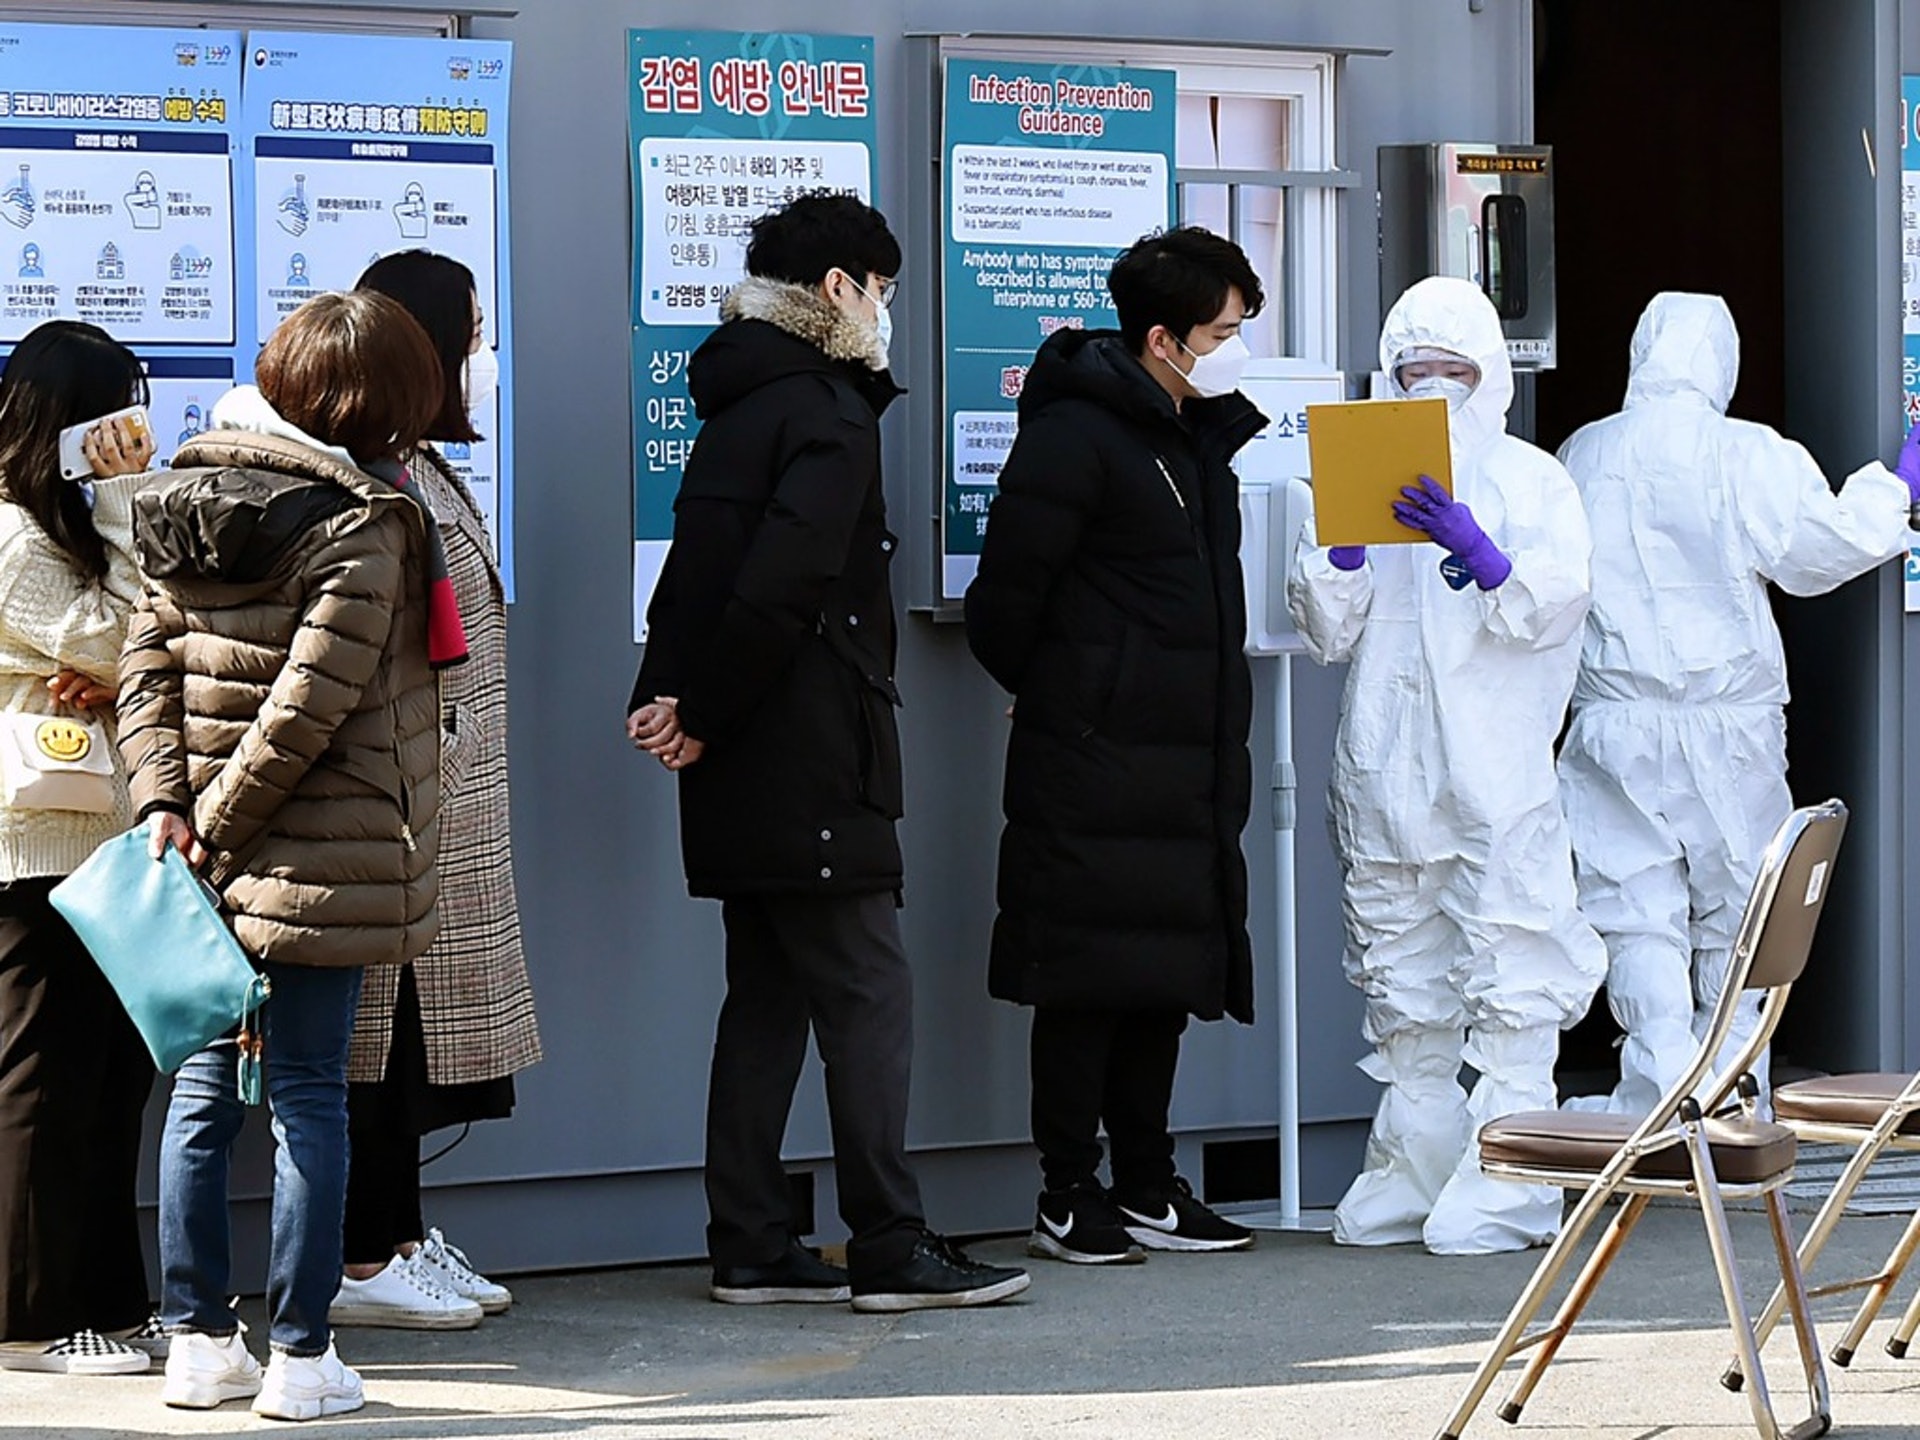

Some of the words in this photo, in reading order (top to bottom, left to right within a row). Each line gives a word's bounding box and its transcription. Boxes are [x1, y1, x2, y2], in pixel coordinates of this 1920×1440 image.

[640, 57, 702, 112] 감염
[712, 58, 773, 116] 예방
[778, 60, 870, 117] 안내문
[970, 75, 1051, 105] Infection
[1057, 80, 1152, 111] Prevention
[13, 93, 161, 120] 코로나바이러스감염증
[163, 97, 193, 121] 예방
[195, 98, 225, 123] 수칙
[1019, 106, 1103, 136] Guidance
[664, 154, 691, 178] 최근
[695, 156, 716, 178] 2주
[720, 157, 747, 179] 이내
[749, 156, 777, 179] 해외
[781, 157, 807, 179] 거주
[811, 157, 823, 180] 및
[665, 184, 718, 208] 여행자로
[721, 184, 749, 208] 발열
[670, 243, 718, 268] 인후통)
[963, 250, 1014, 271] Anybody
[1016, 253, 1040, 269] who
[1042, 253, 1062, 271] has
[976, 270, 1033, 288] described
[1036, 271, 1046, 288] is
[1048, 272, 1091, 290] allowed
[1094, 274, 1107, 290] to
[665, 285, 706, 309] 감염병
[993, 289, 1056, 310] interphone
[1058, 293, 1071, 308] or
[1000, 366, 1027, 398] 感
[646, 397, 688, 430] 이곳
